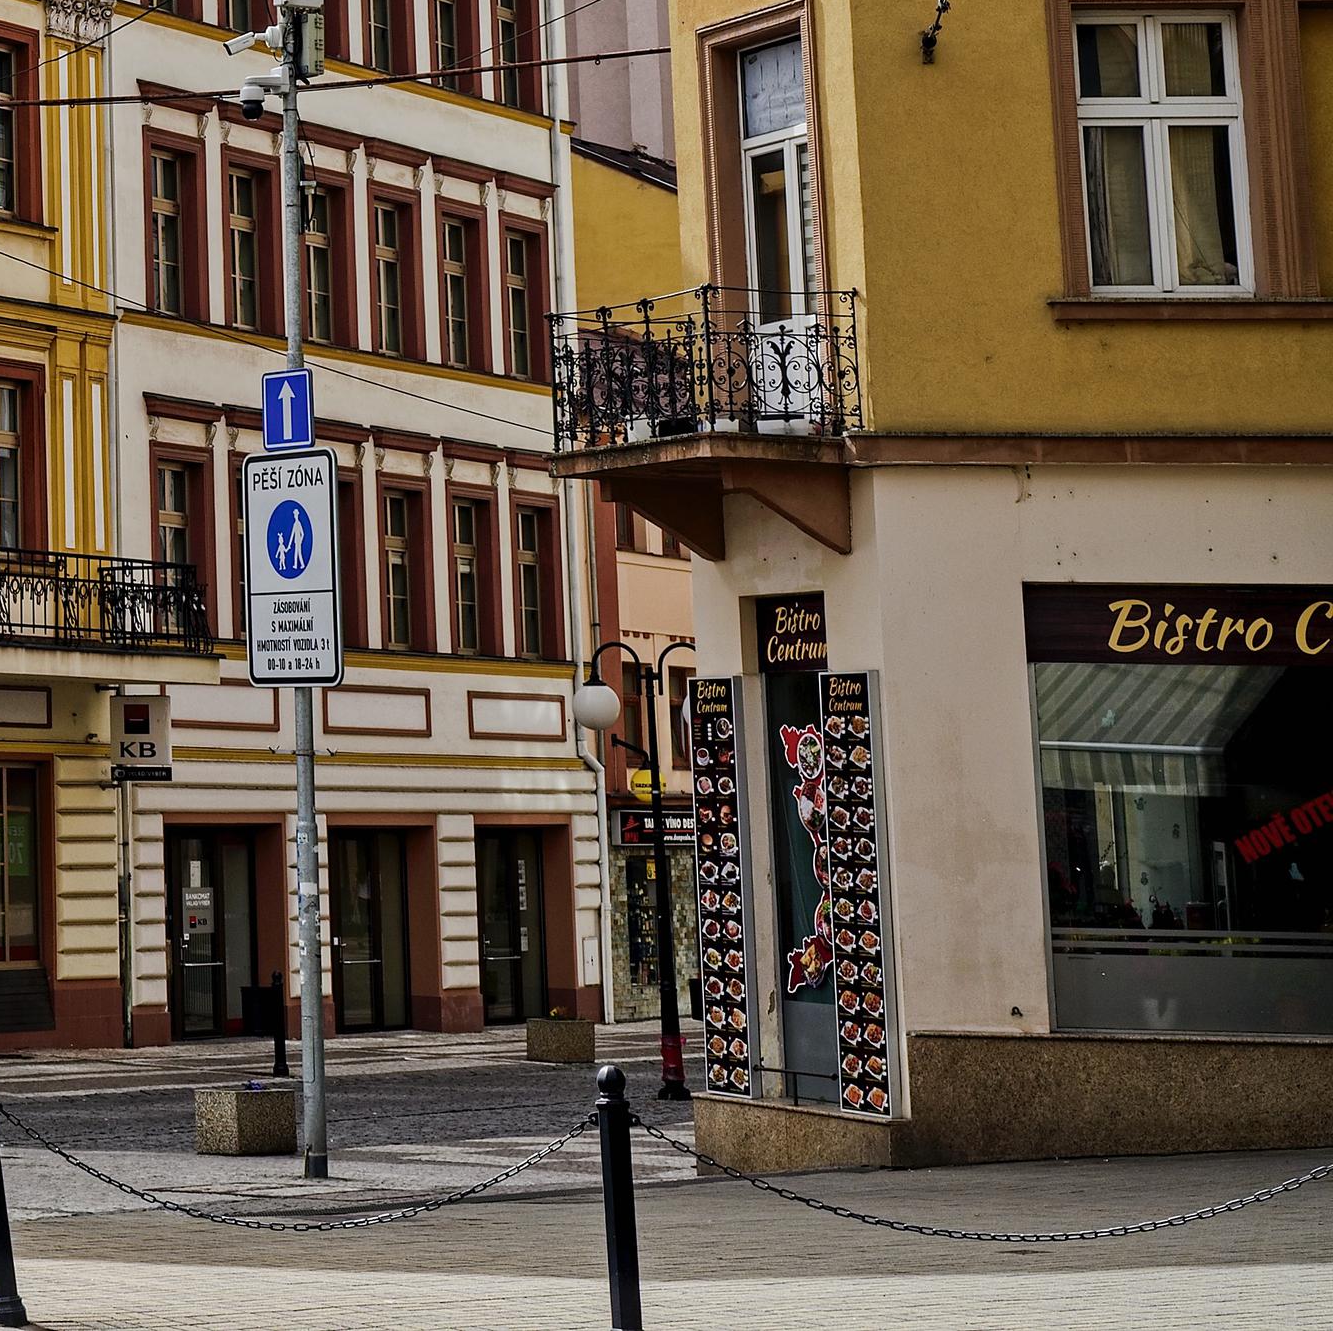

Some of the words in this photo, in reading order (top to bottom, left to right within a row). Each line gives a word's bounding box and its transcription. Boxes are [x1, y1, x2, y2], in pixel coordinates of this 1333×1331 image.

[253, 466, 282, 491] PĚŠÍ
[287, 464, 324, 488] ZÓNA
[273, 598, 311, 614] ZÁSOBOVÁNÍ
[271, 620, 276, 633] S
[278, 616, 314, 633] MAXIMÁLNÍ
[775, 606, 821, 634] Bistro
[1108, 599, 1274, 655] Bistro
[256, 636, 291, 652] HMOTNOSTÍ
[293, 638, 319, 651] VOZIDLA
[321, 638, 326, 650] 3
[267, 658, 286, 671] 00-10
[288, 661, 293, 670] a
[294, 658, 314, 670] 18-24
[315, 657, 321, 670] h
[697, 680, 726, 699] Bistro
[829, 677, 862, 696] Bistro
[120, 741, 157, 758] KB
[1235, 811, 1296, 862] NOVĚ
